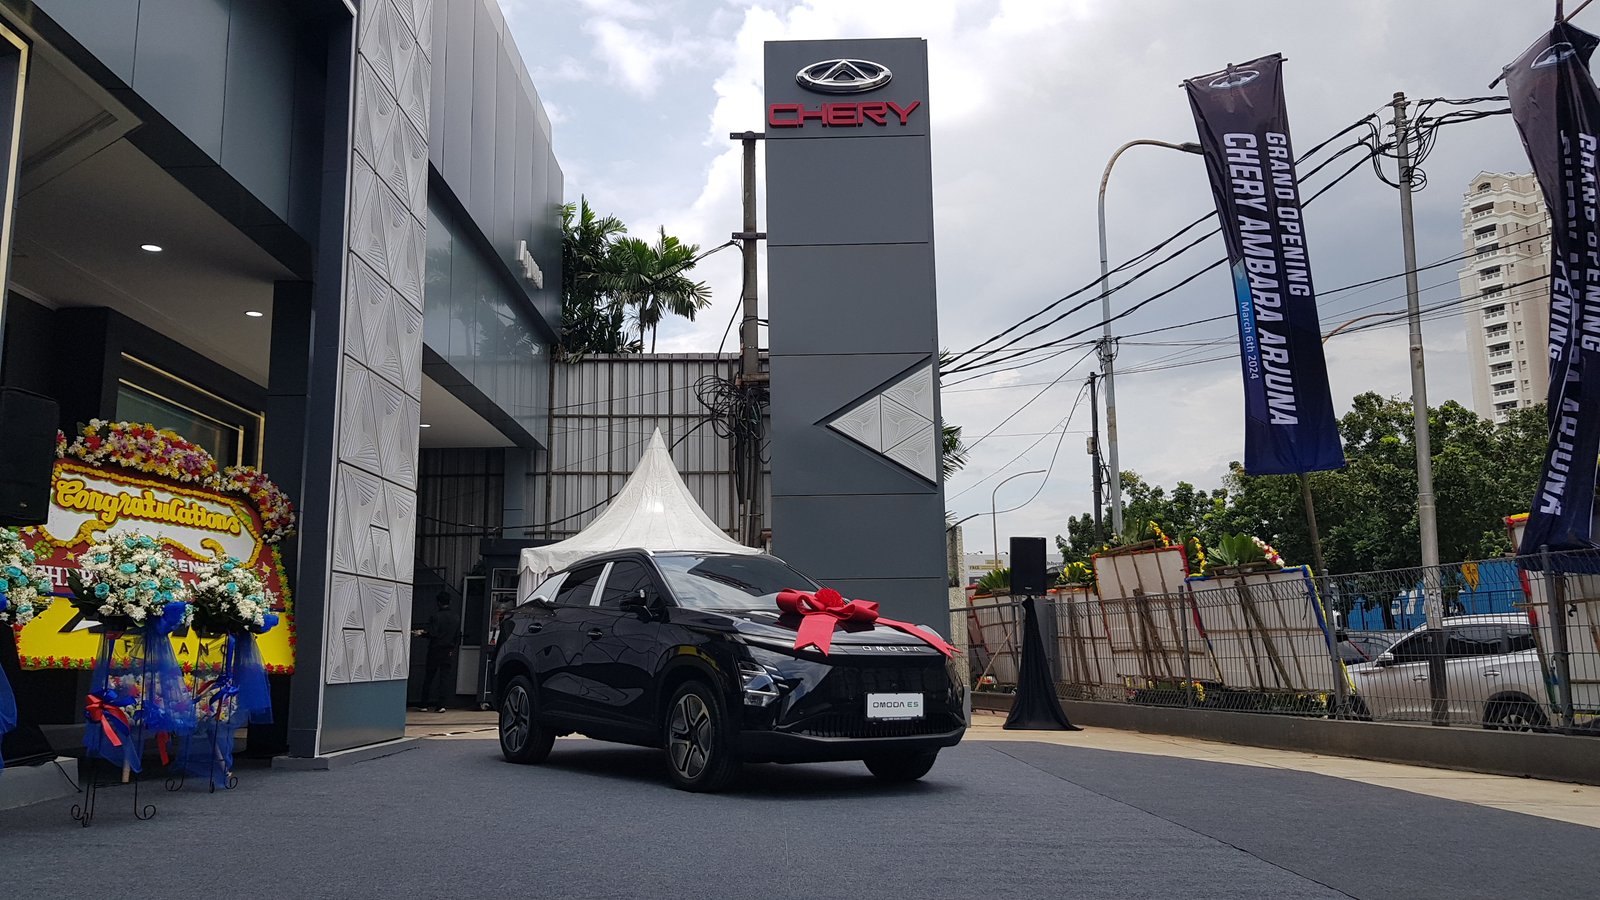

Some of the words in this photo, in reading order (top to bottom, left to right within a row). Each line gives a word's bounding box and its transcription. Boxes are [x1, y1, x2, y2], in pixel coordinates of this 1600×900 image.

[768, 101, 921, 129] CHERY
[1223, 132, 1268, 212] CHERY
[1265, 132, 1295, 200] GRAND
[1237, 214, 1284, 322] AMBARA
[1276, 206, 1311, 297] OPENING
[1241, 301, 1252, 334] March
[1245, 335, 1254, 353] 6th
[1247, 354, 1260, 380] 2024
[1258, 327, 1299, 425] ARJUNA
[55, 479, 243, 534] Congratulations
